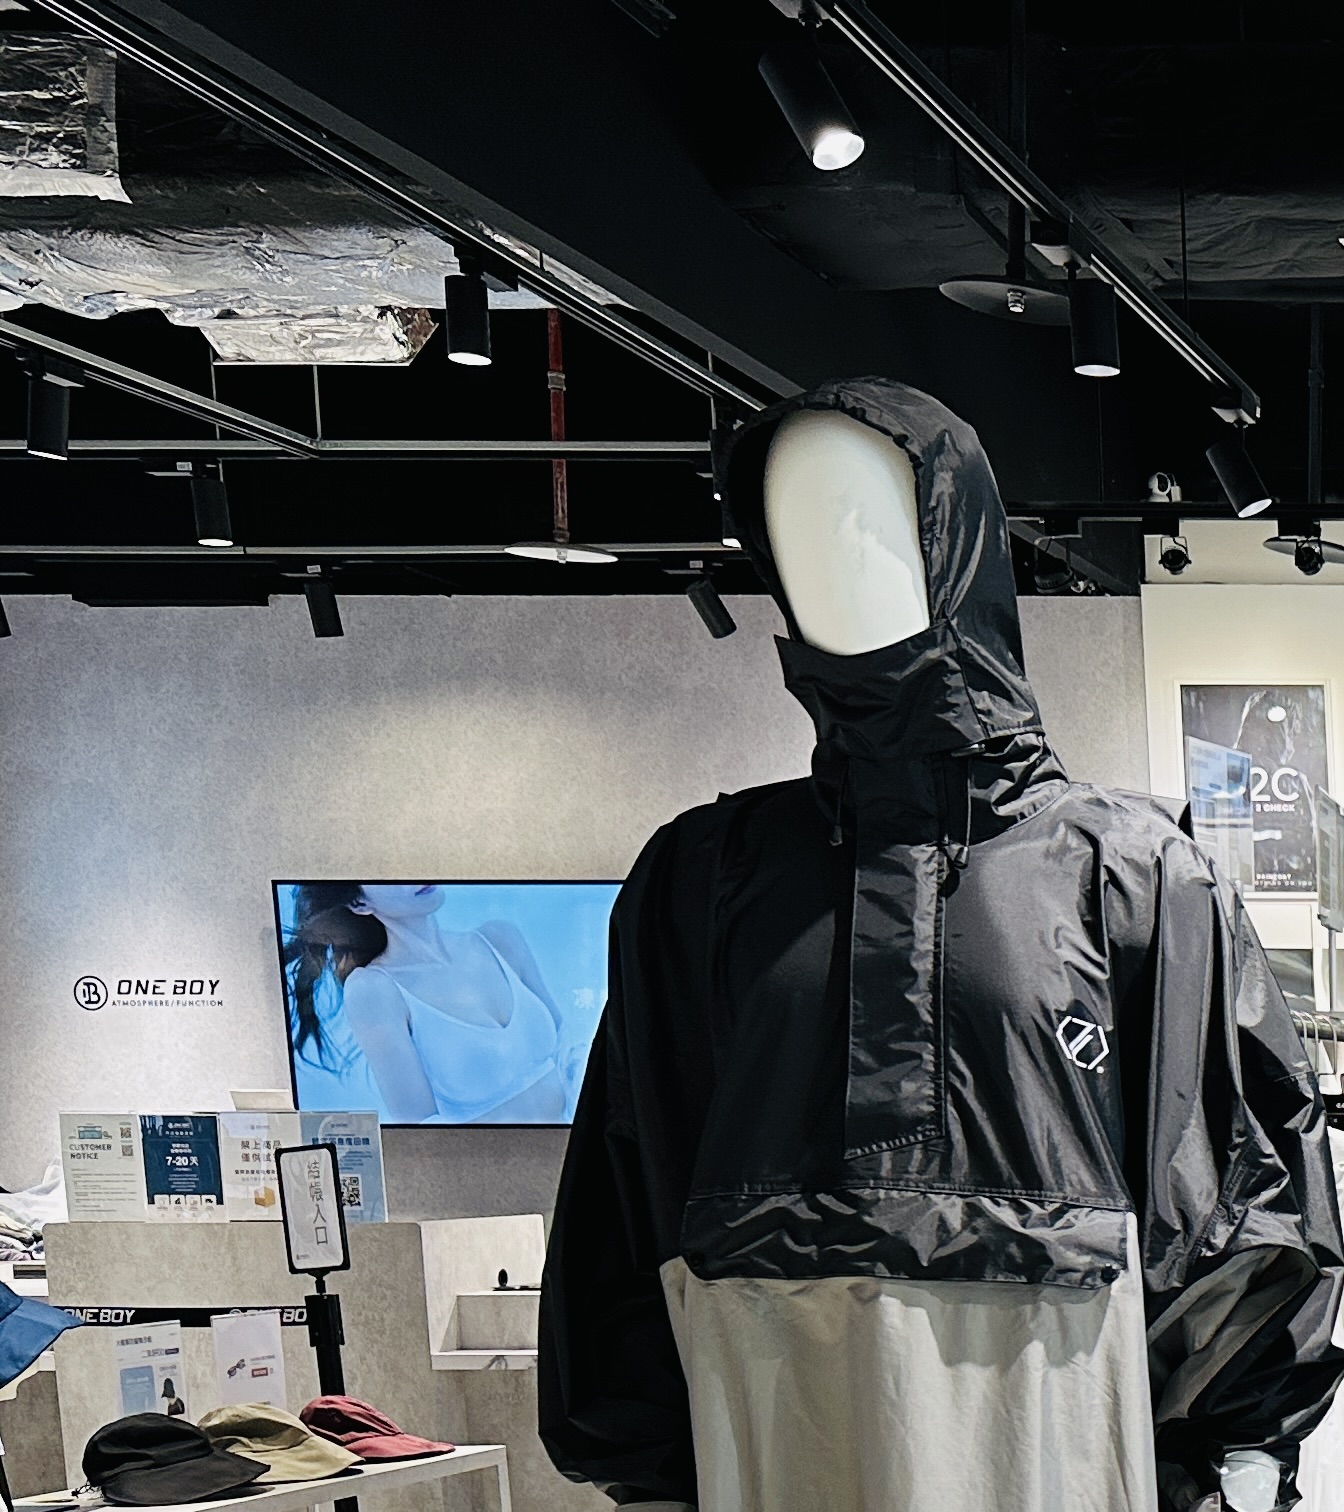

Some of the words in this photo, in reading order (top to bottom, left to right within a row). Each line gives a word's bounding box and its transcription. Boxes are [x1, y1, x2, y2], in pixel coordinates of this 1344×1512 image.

[1250, 767, 1299, 801] 2C
[117, 980, 167, 995] ONE
[173, 979, 220, 995] BOY
[70, 1152, 99, 1160] NOTICE
[100, 1309, 136, 1323] BOY
[282, 1308, 307, 1322] BO
